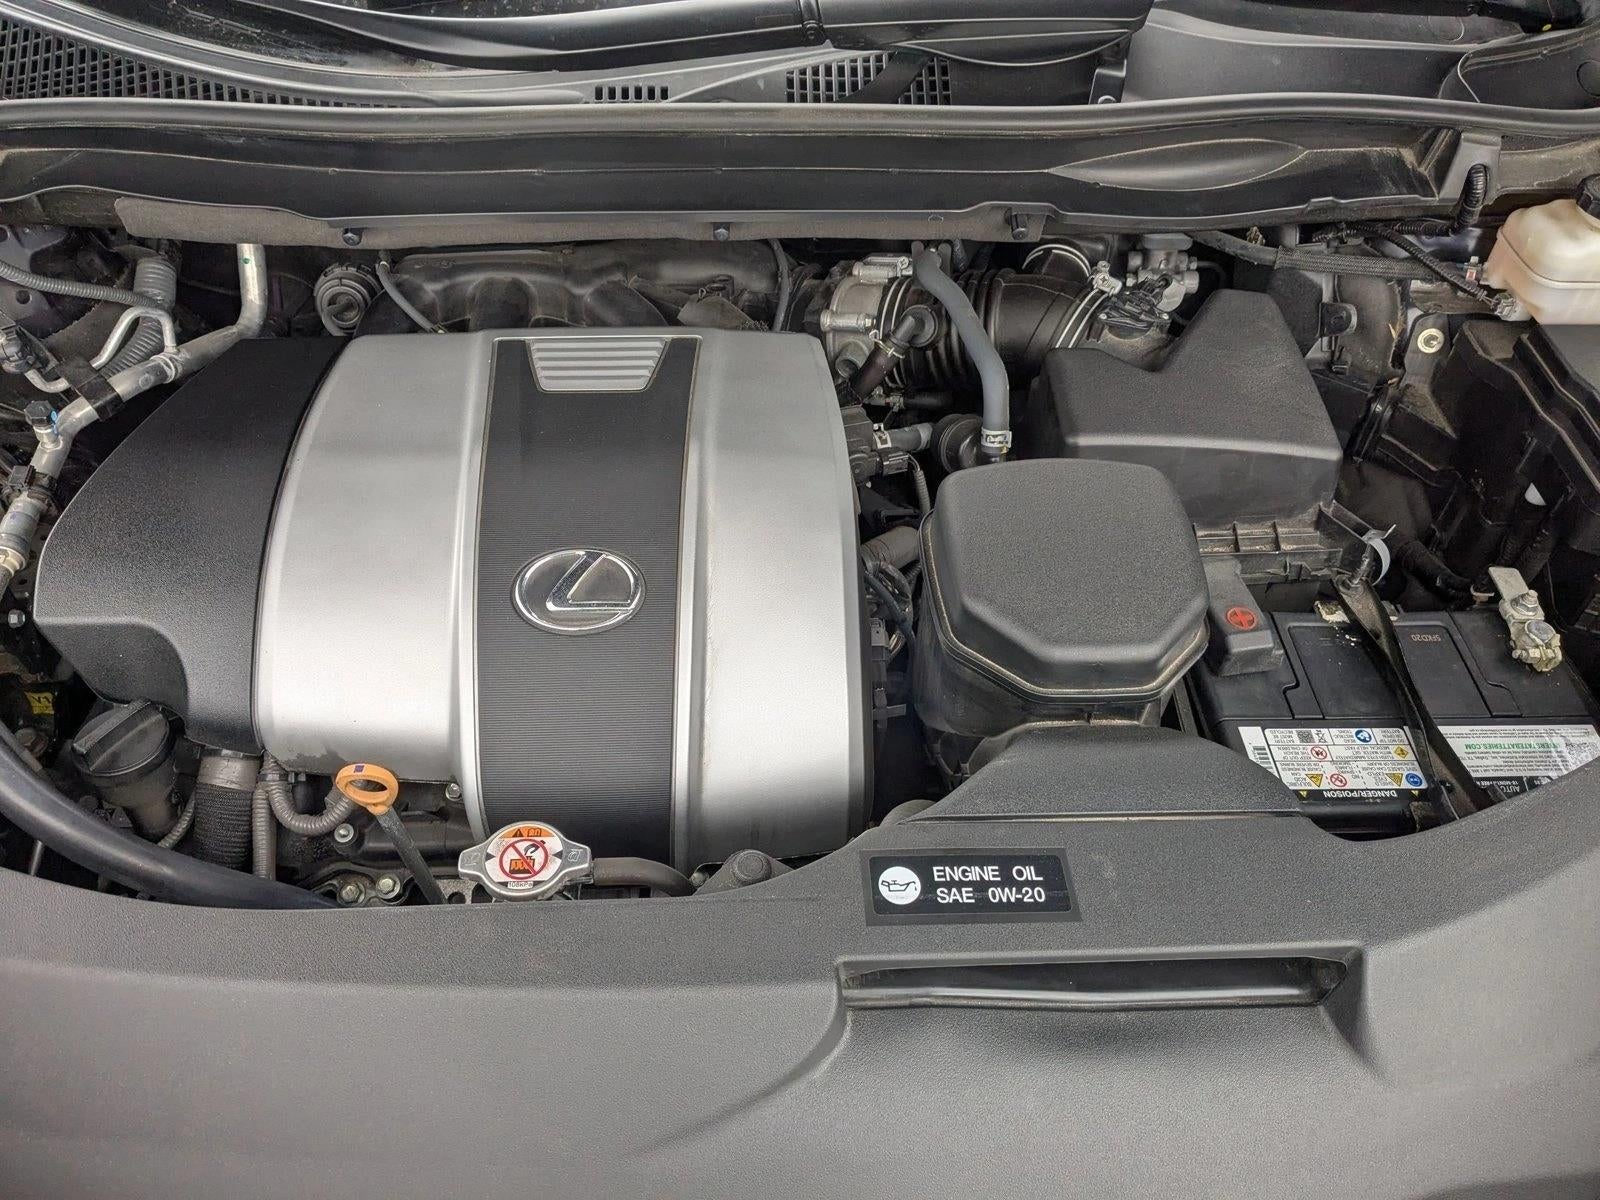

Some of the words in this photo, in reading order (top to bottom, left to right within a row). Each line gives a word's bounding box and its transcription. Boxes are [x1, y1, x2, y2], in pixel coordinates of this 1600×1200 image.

[1323, 790, 1398, 798] DANGER/POISON
[933, 866, 1001, 881] ENGINE
[1012, 866, 1044, 881] OIL
[936, 888, 975, 903] SAE
[988, 887, 1046, 903] 0W-20
